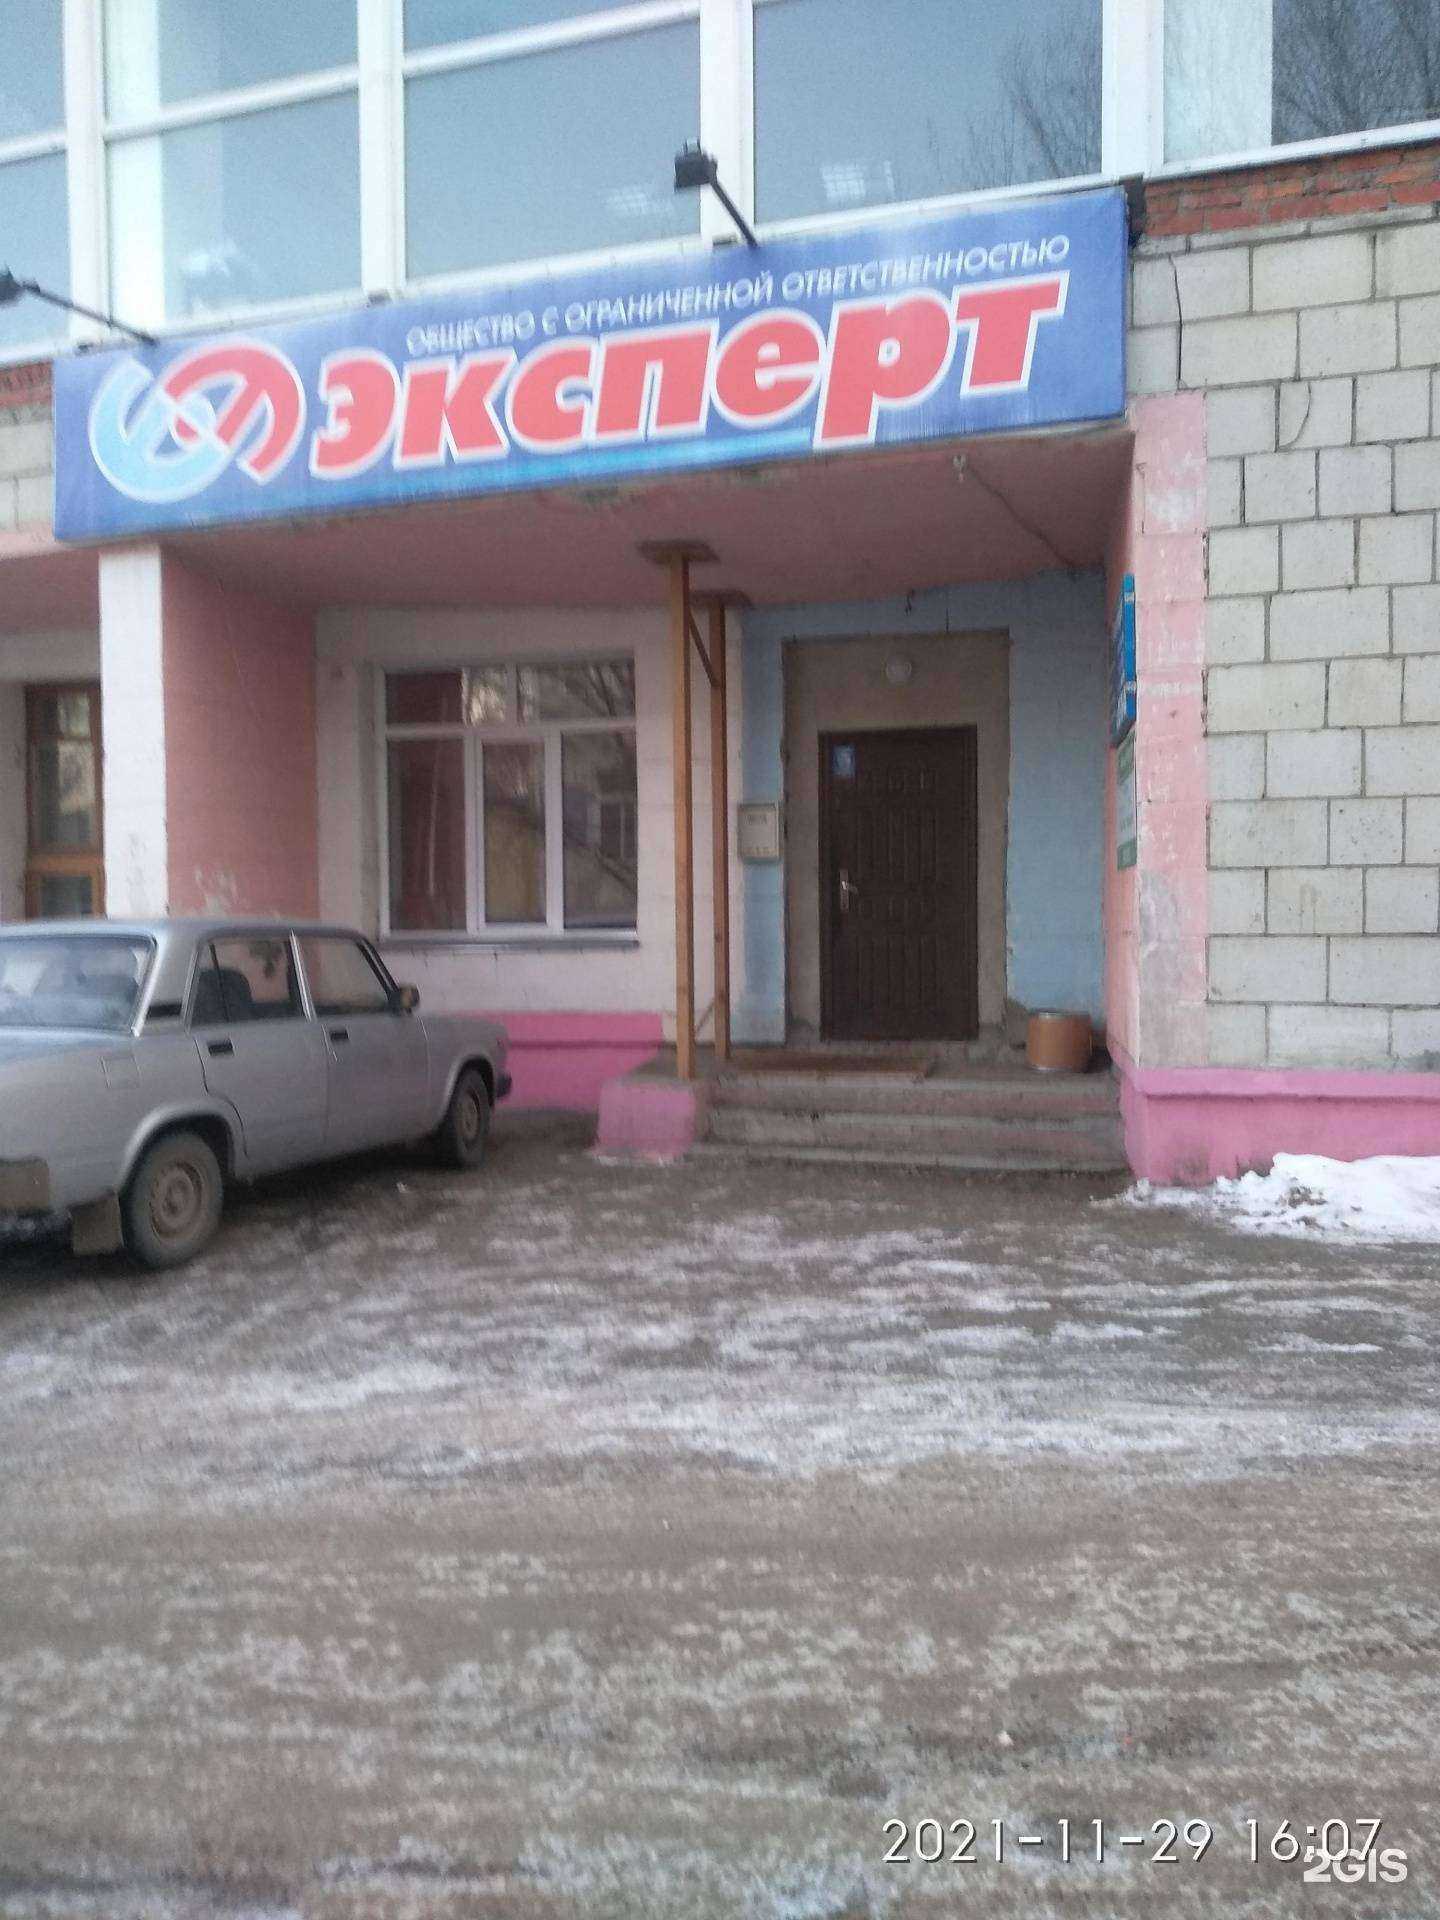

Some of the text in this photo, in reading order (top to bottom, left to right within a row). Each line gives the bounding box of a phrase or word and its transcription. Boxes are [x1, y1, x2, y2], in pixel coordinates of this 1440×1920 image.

[405, 233, 1071, 356] ОБЩЕСТВО С ОГРАНИЧЕННОЙ ОТВЕТСТВЕННОСТЬЮ
